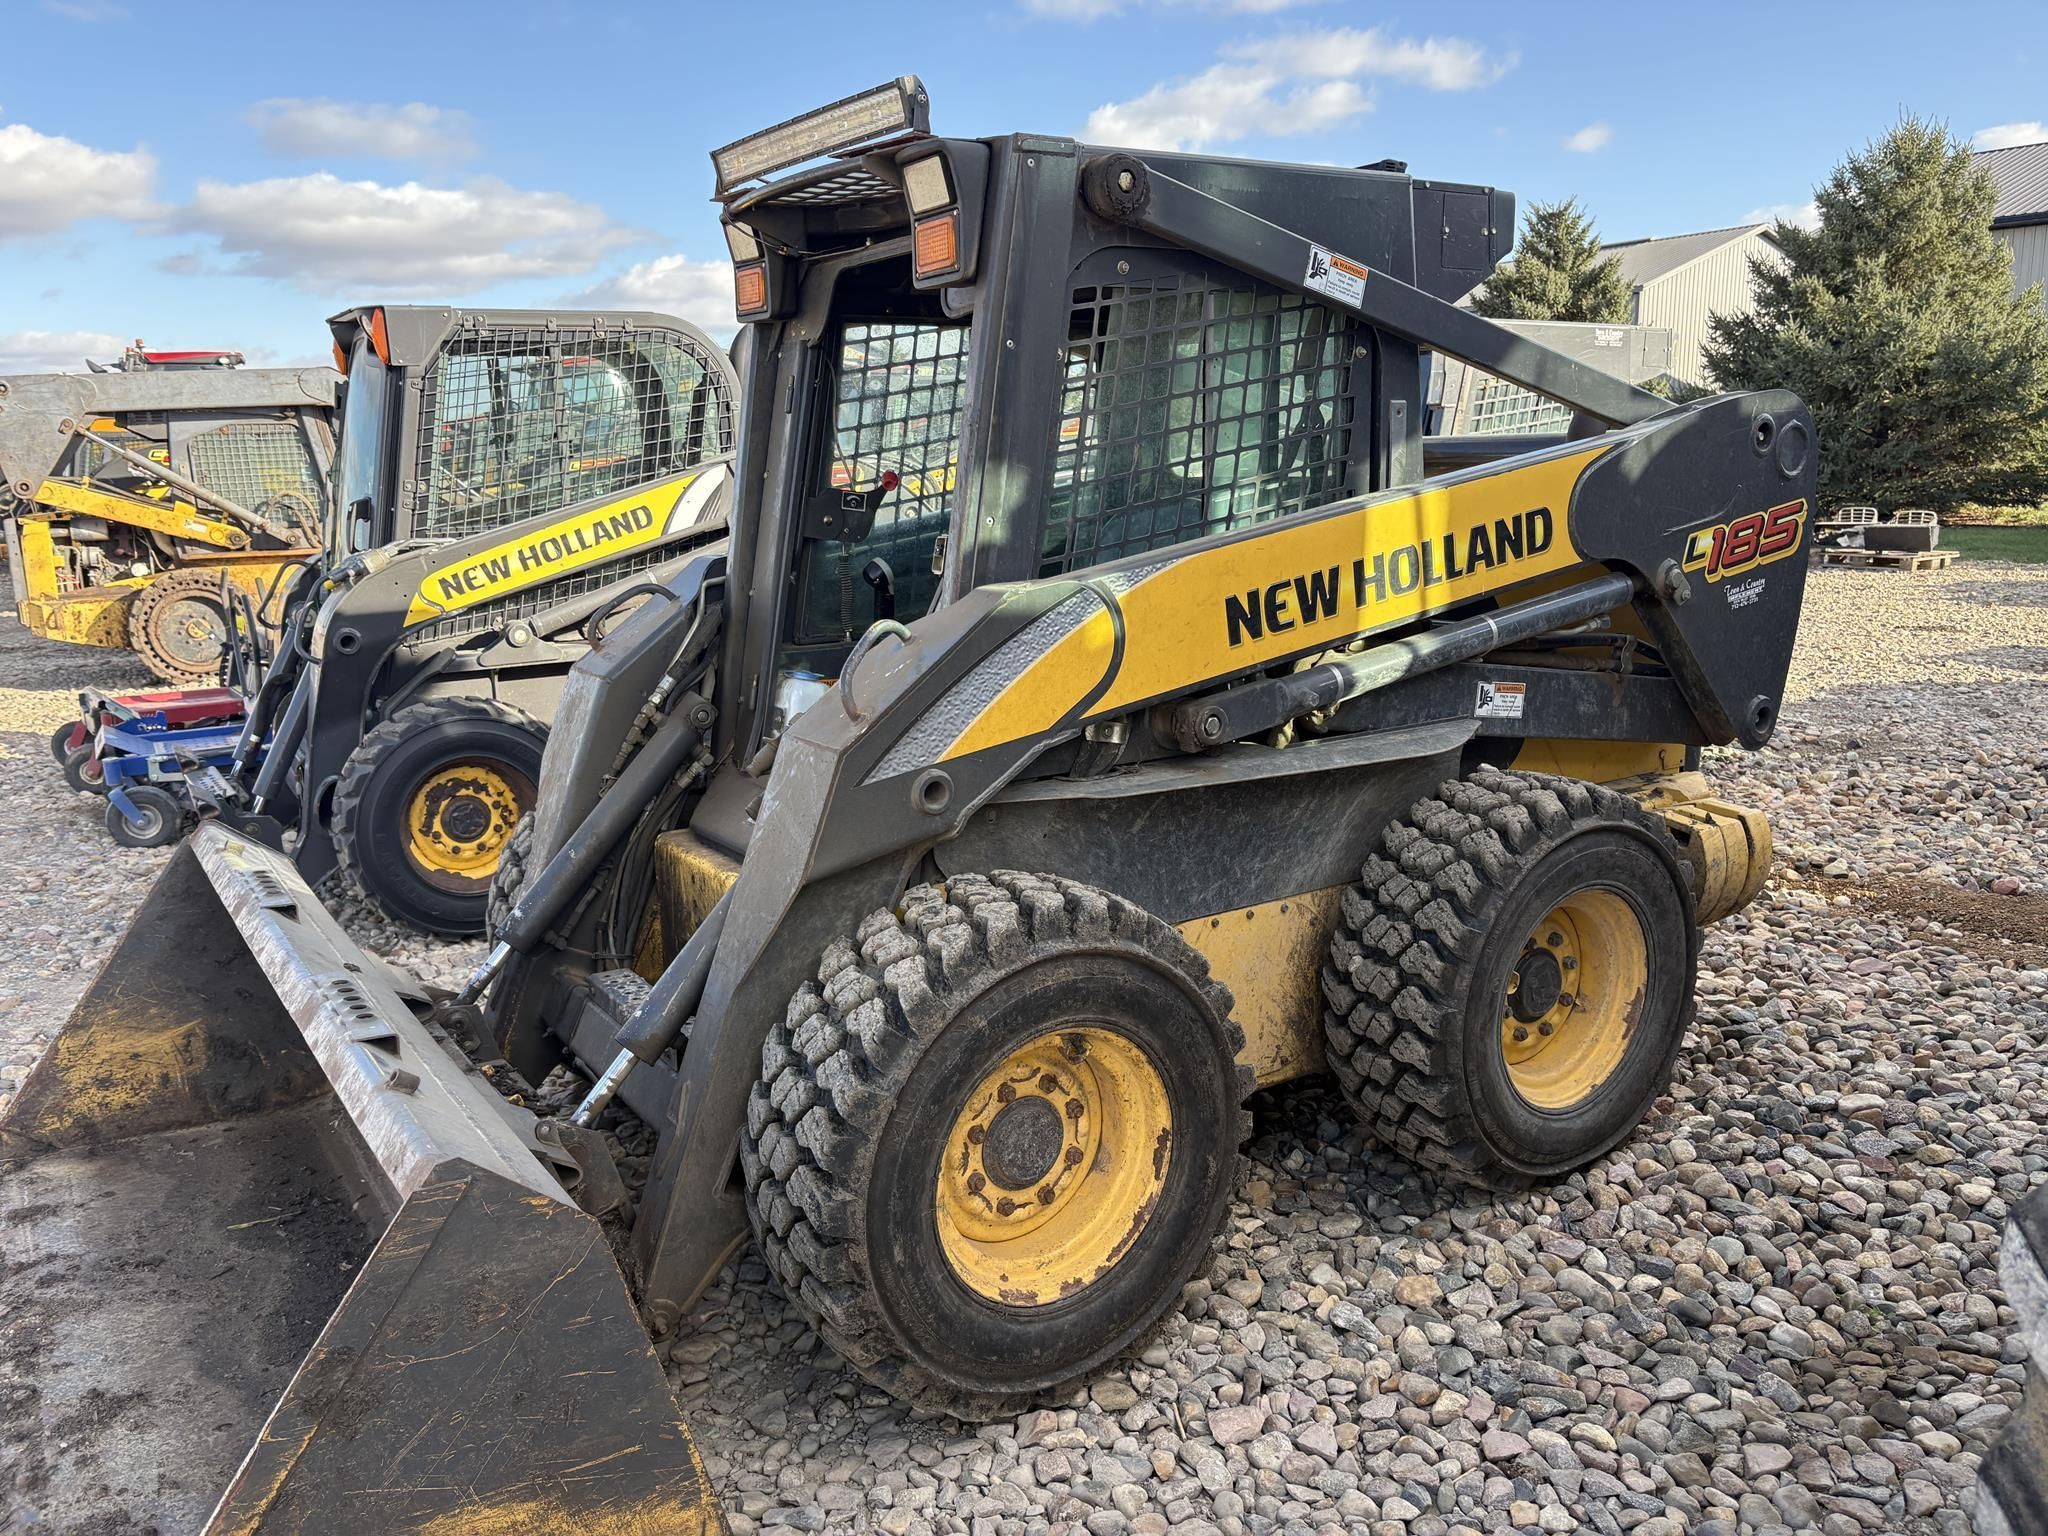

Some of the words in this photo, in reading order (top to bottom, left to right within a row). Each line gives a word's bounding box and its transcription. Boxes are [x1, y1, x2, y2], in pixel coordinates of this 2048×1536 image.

[1339, 263, 1364, 277] WARNING
[437, 554, 512, 600] NEW
[517, 505, 654, 572] HOLLAND
[1224, 564, 1340, 648] NEW
[1352, 506, 1553, 608] HOLLAND
[1682, 498, 1808, 583] L185
[1724, 585, 1740, 597] Town
[1740, 583, 1745, 591] &
[1746, 578, 1766, 588] Country
